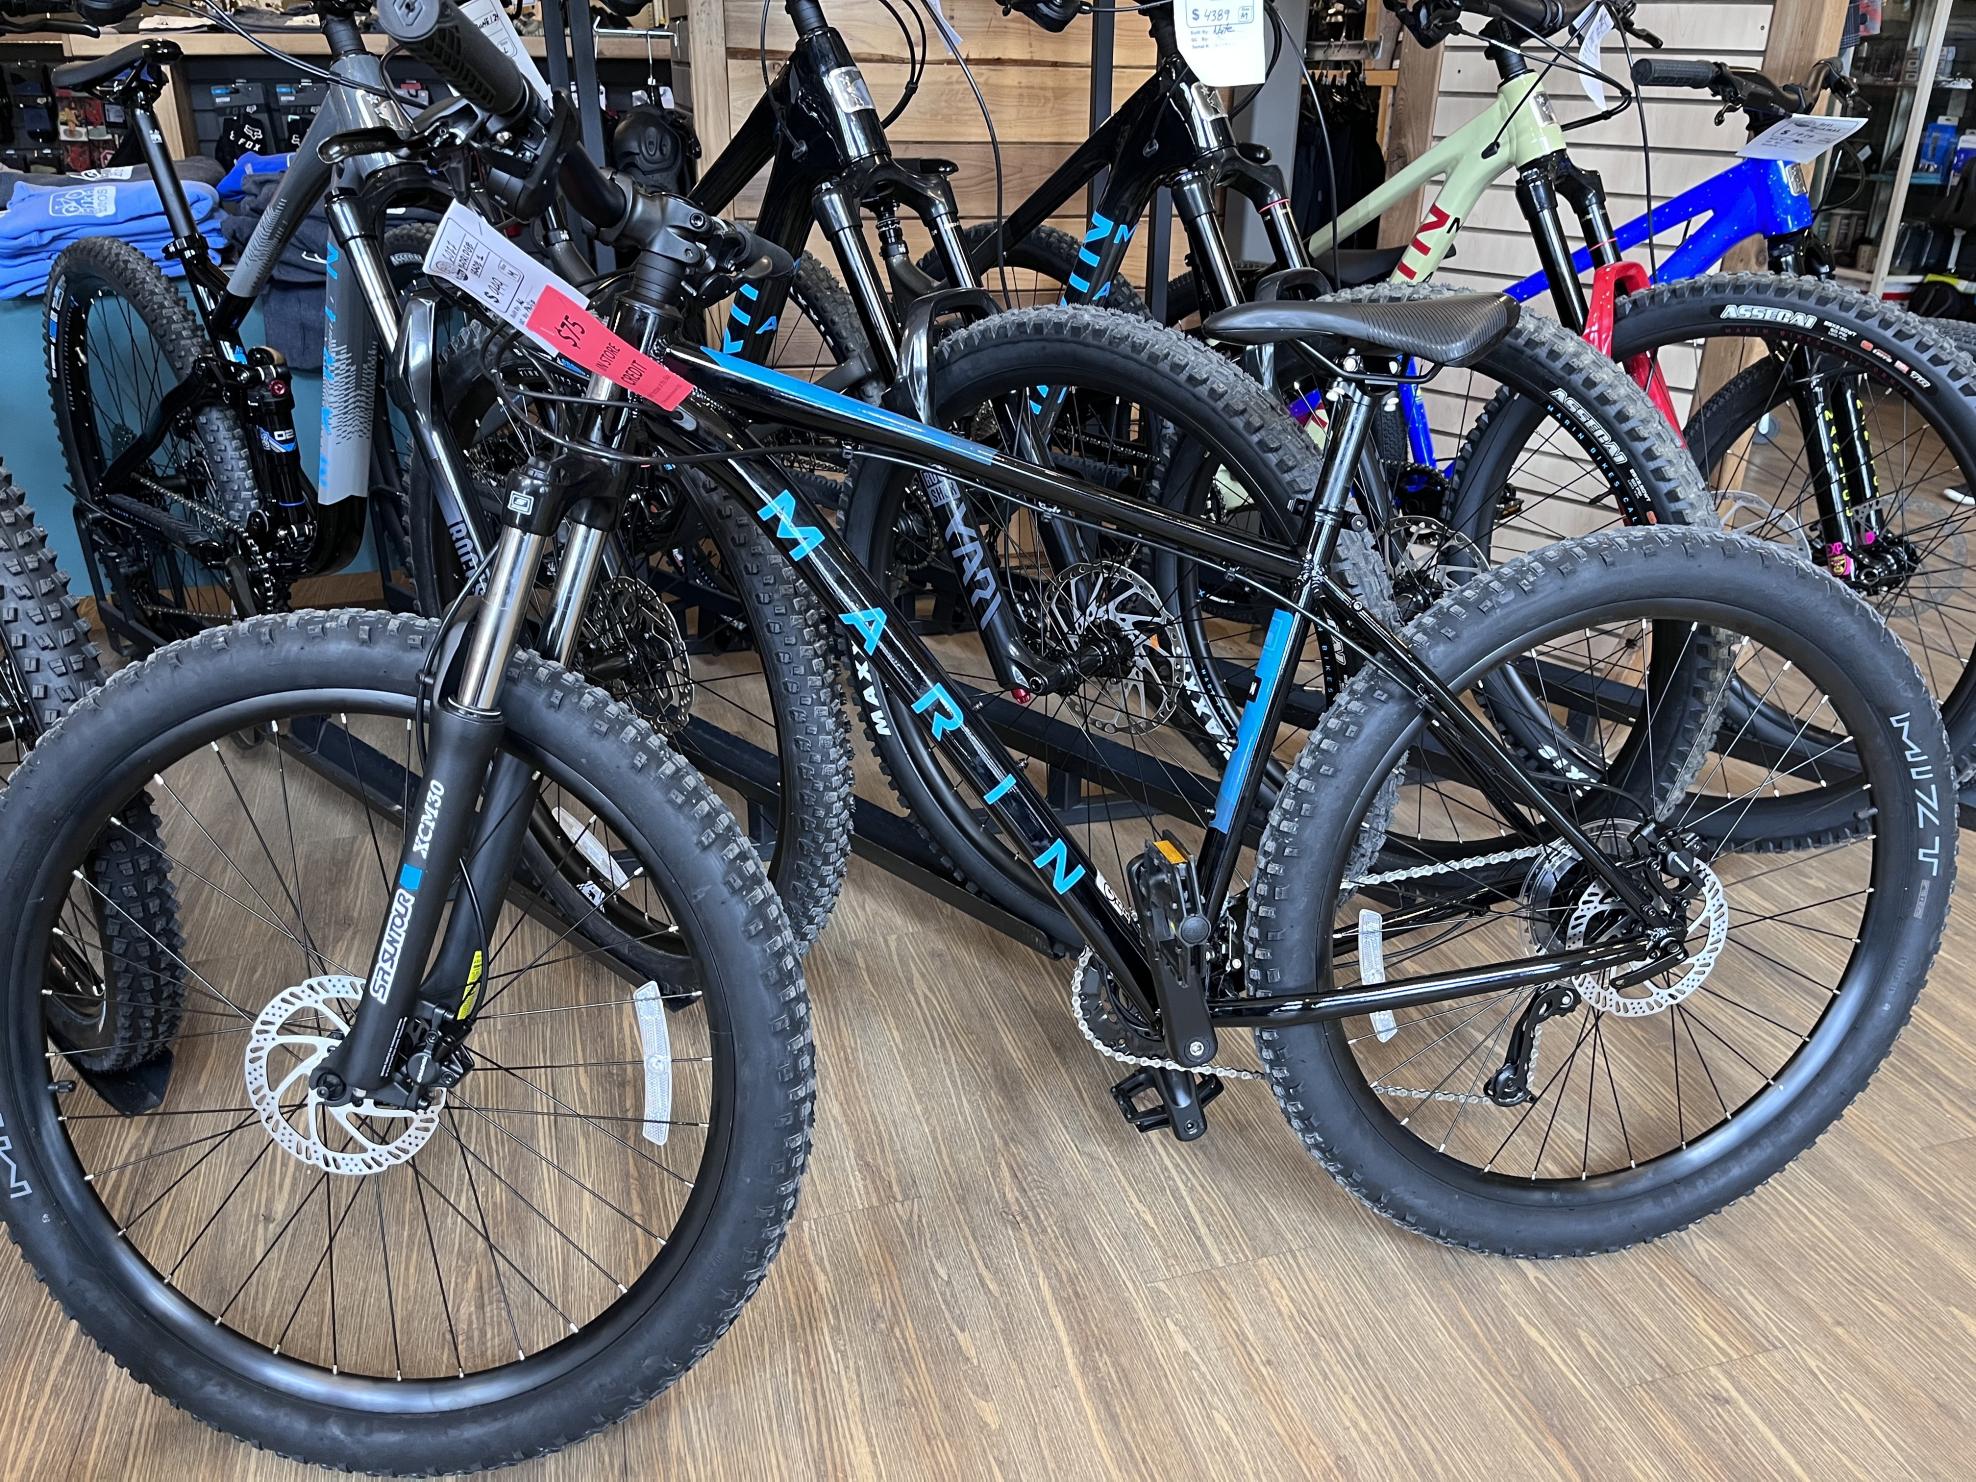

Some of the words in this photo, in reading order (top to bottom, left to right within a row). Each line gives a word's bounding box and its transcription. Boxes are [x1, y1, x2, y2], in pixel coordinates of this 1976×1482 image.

[1204, 9, 1230, 22] 4389
[237, 137, 261, 151] FOX
[555, 314, 586, 350] $75
[1720, 304, 1818, 329] ASSEGAI
[595, 360, 607, 372] IN
[602, 342, 621, 366] STORE
[620, 360, 648, 386] CREDIT
[1547, 404, 1585, 440] MARIN
[1590, 447, 1620, 488] BIKES
[1549, 387, 1628, 465] ASSEGAI
[940, 500, 1003, 631] YARI
[757, 489, 1086, 895] MARIN
[412, 779, 446, 859] XCM30
[378, 891, 415, 968] SUNTOUR
[370, 961, 392, 1002] SR
